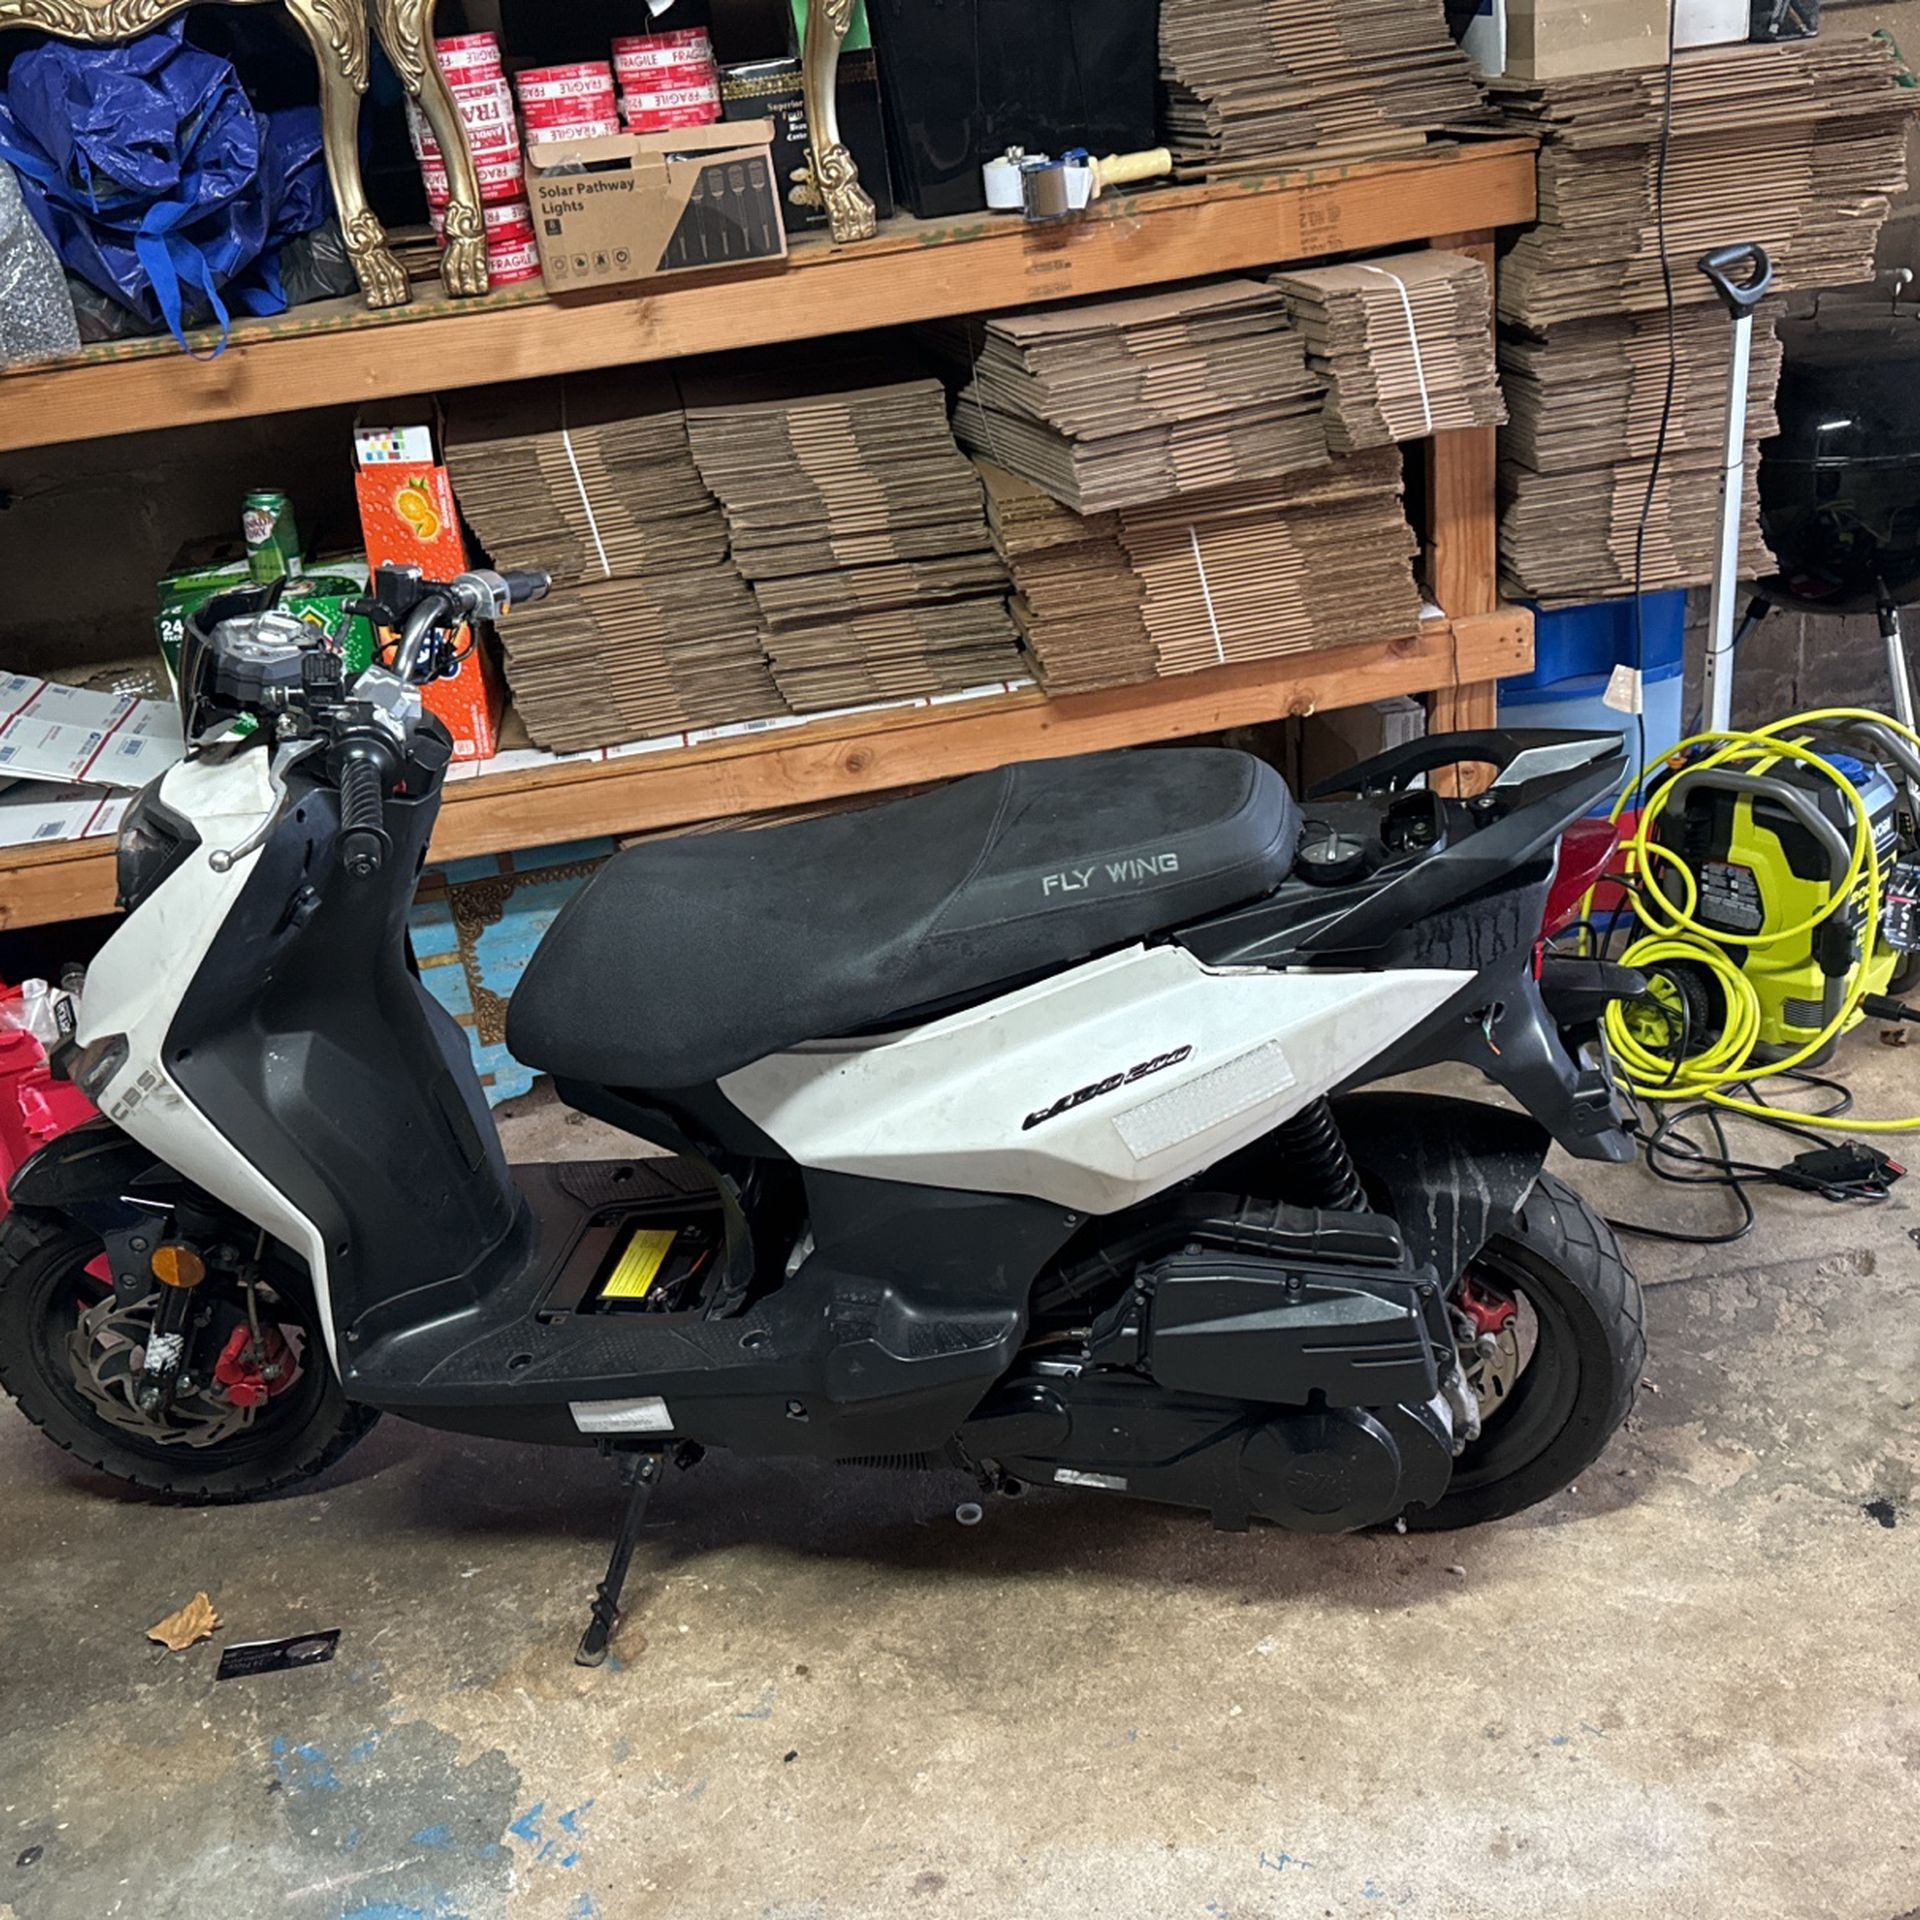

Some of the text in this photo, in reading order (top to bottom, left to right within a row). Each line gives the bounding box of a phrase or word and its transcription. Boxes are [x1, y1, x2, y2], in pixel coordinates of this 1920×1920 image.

[538, 179, 635, 199] Solar Pathway
[541, 200, 584, 217] Lights
[489, 253, 532, 270] FRAGILE
[160, 619, 184, 636] 24
[1042, 853, 1179, 896] FLY WING
